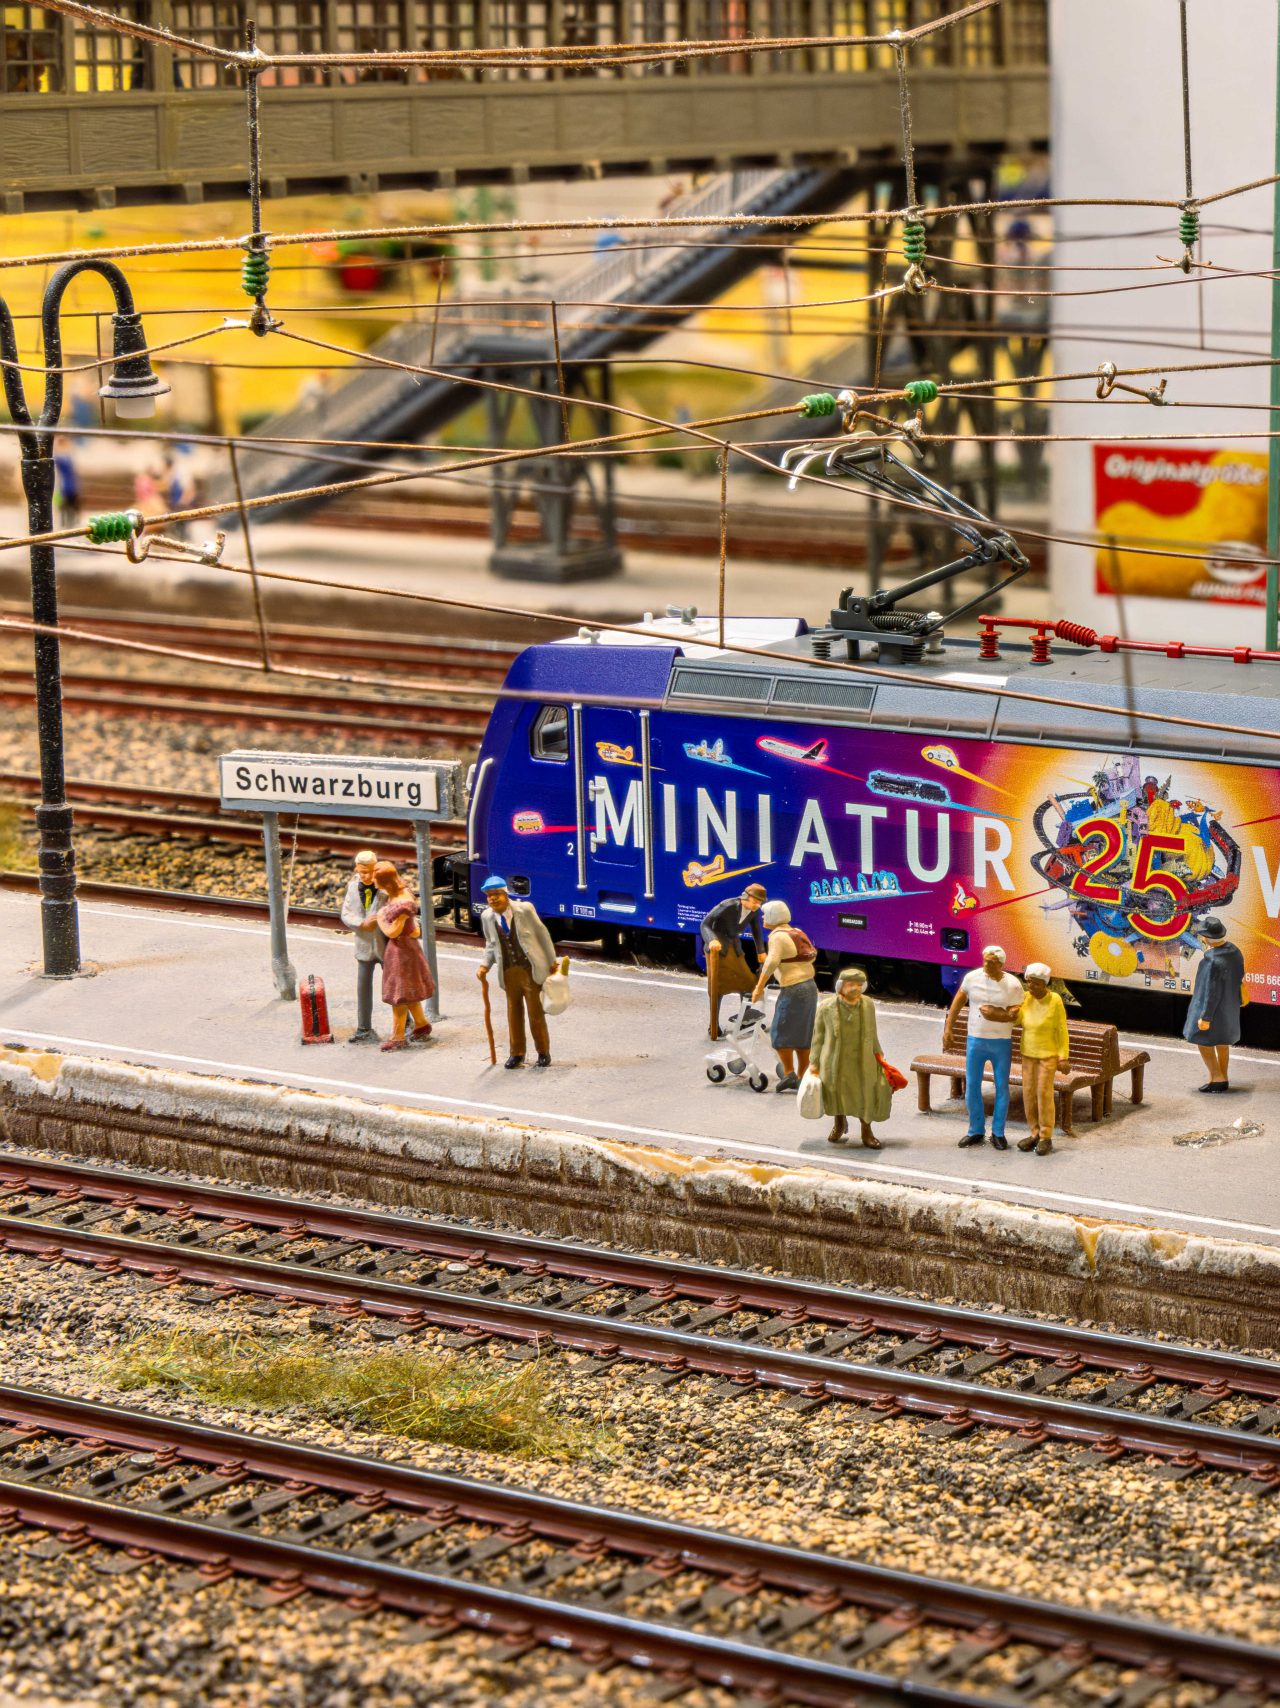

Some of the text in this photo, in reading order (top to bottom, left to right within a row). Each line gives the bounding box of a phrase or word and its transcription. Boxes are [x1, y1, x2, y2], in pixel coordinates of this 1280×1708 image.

[1104, 453, 1267, 488] Originalgröße
[236, 766, 422, 807] Schwarzburg
[567, 842, 575, 856] 2
[594, 775, 1017, 892] MINIATUR
[1069, 817, 1193, 941] 25
[1245, 972, 1265, 984] 6185
